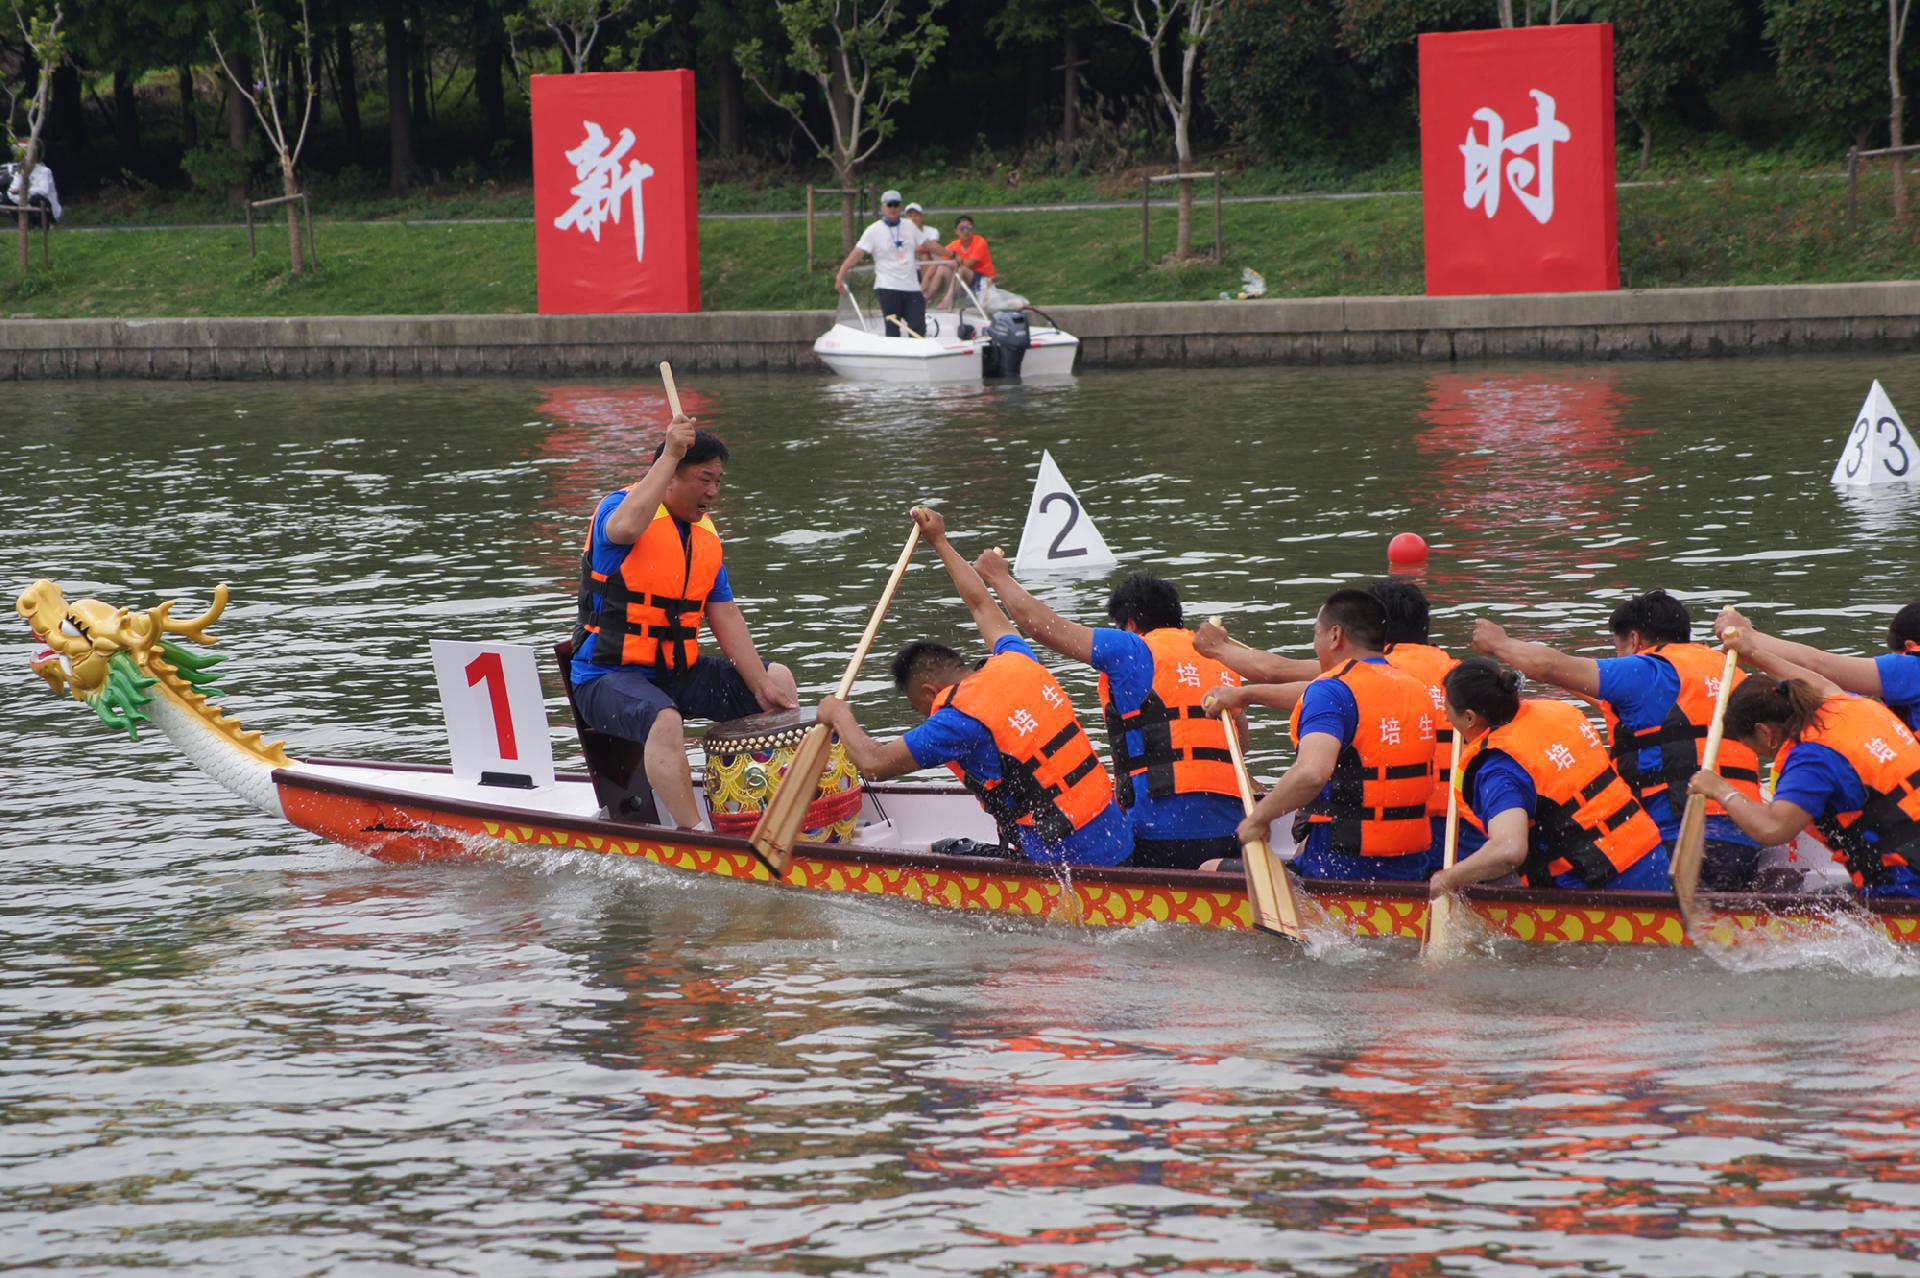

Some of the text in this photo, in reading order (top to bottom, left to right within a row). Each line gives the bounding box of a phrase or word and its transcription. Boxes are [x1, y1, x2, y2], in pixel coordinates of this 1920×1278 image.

[553, 120, 654, 263] 新
[1847, 417, 1869, 478] 3
[1876, 416, 1909, 477] 3
[1039, 492, 1088, 559] 2
[464, 652, 518, 760] 1
[1007, 684, 1064, 737] 培生
[1379, 713, 1433, 746] 培生
[1545, 722, 1600, 772] 培生
[1864, 720, 1915, 764] 培生
